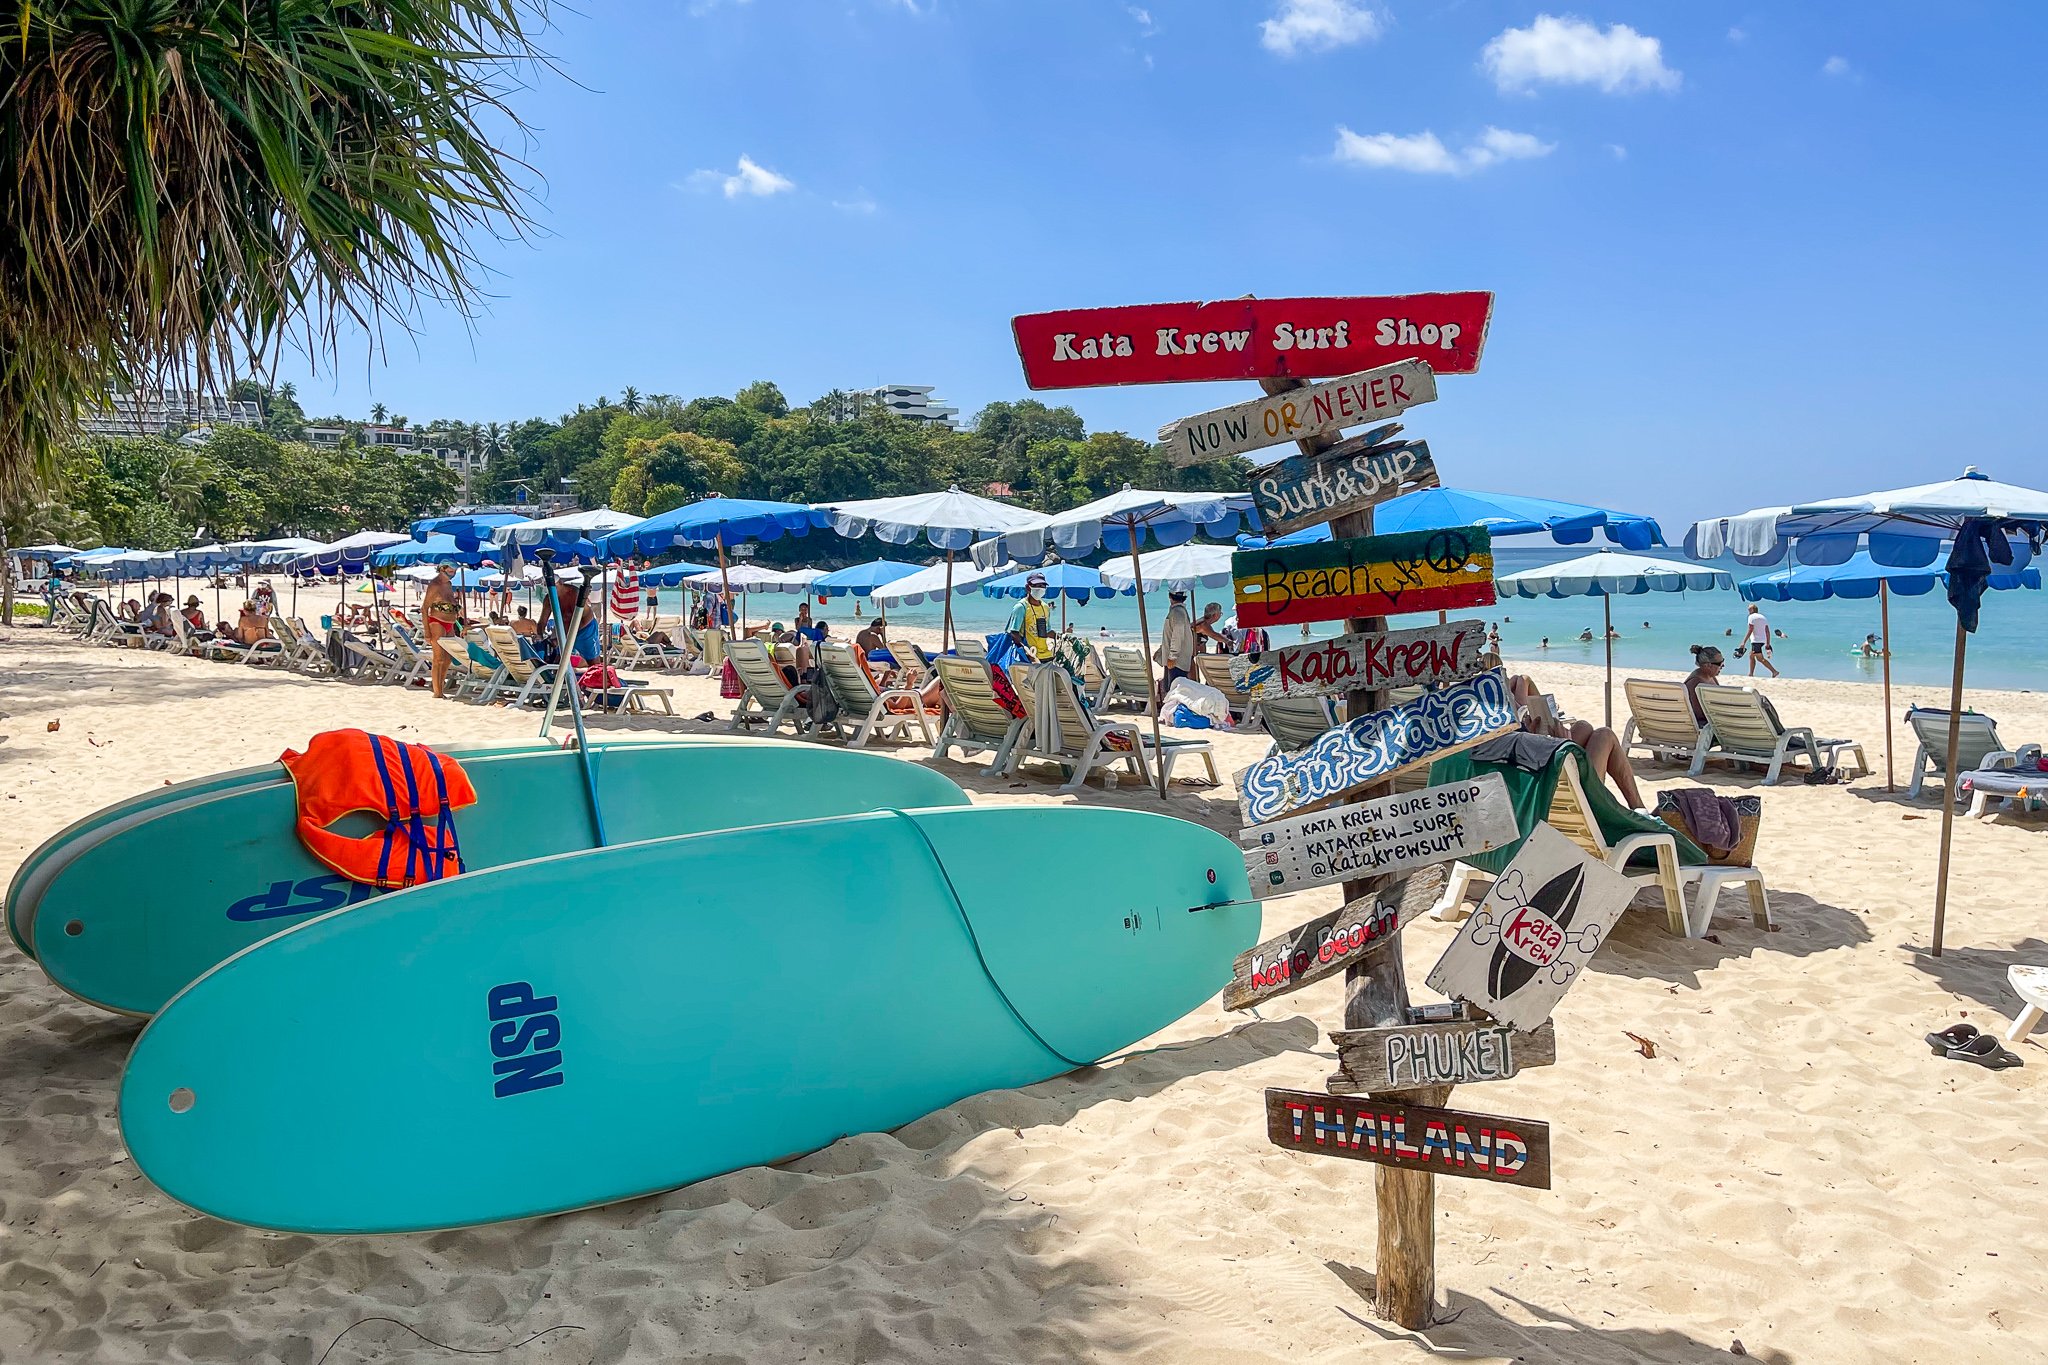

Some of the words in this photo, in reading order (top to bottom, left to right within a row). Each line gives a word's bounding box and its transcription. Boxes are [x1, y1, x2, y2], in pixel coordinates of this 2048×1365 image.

[1053, 333, 1133, 361] Kata
[1154, 328, 1251, 356] Krew
[1272, 320, 1351, 350] Surf
[1374, 318, 1462, 350] Shop
[1187, 419, 1249, 455] NOW
[1263, 402, 1302, 438] OR
[1312, 373, 1411, 424] NEVER
[1264, 552, 1370, 616] Beach
[1279, 640, 1357, 692] Kata
[1365, 631, 1467, 686] Krew
[1301, 818, 1337, 837] KATA
[1341, 806, 1383, 830] KREW
[1437, 786, 1481, 808] SHOP
[1306, 811, 1457, 859] KATAKREW_SURF
[1311, 824, 1465, 878] @katakrewsurf
[1251, 943, 1312, 991] Kata
[1316, 900, 1399, 964] Beach
[487, 981, 564, 1099] NSP
[1385, 1025, 1517, 1087] PHUKET
[1284, 1101, 1528, 1176] THAILAND
